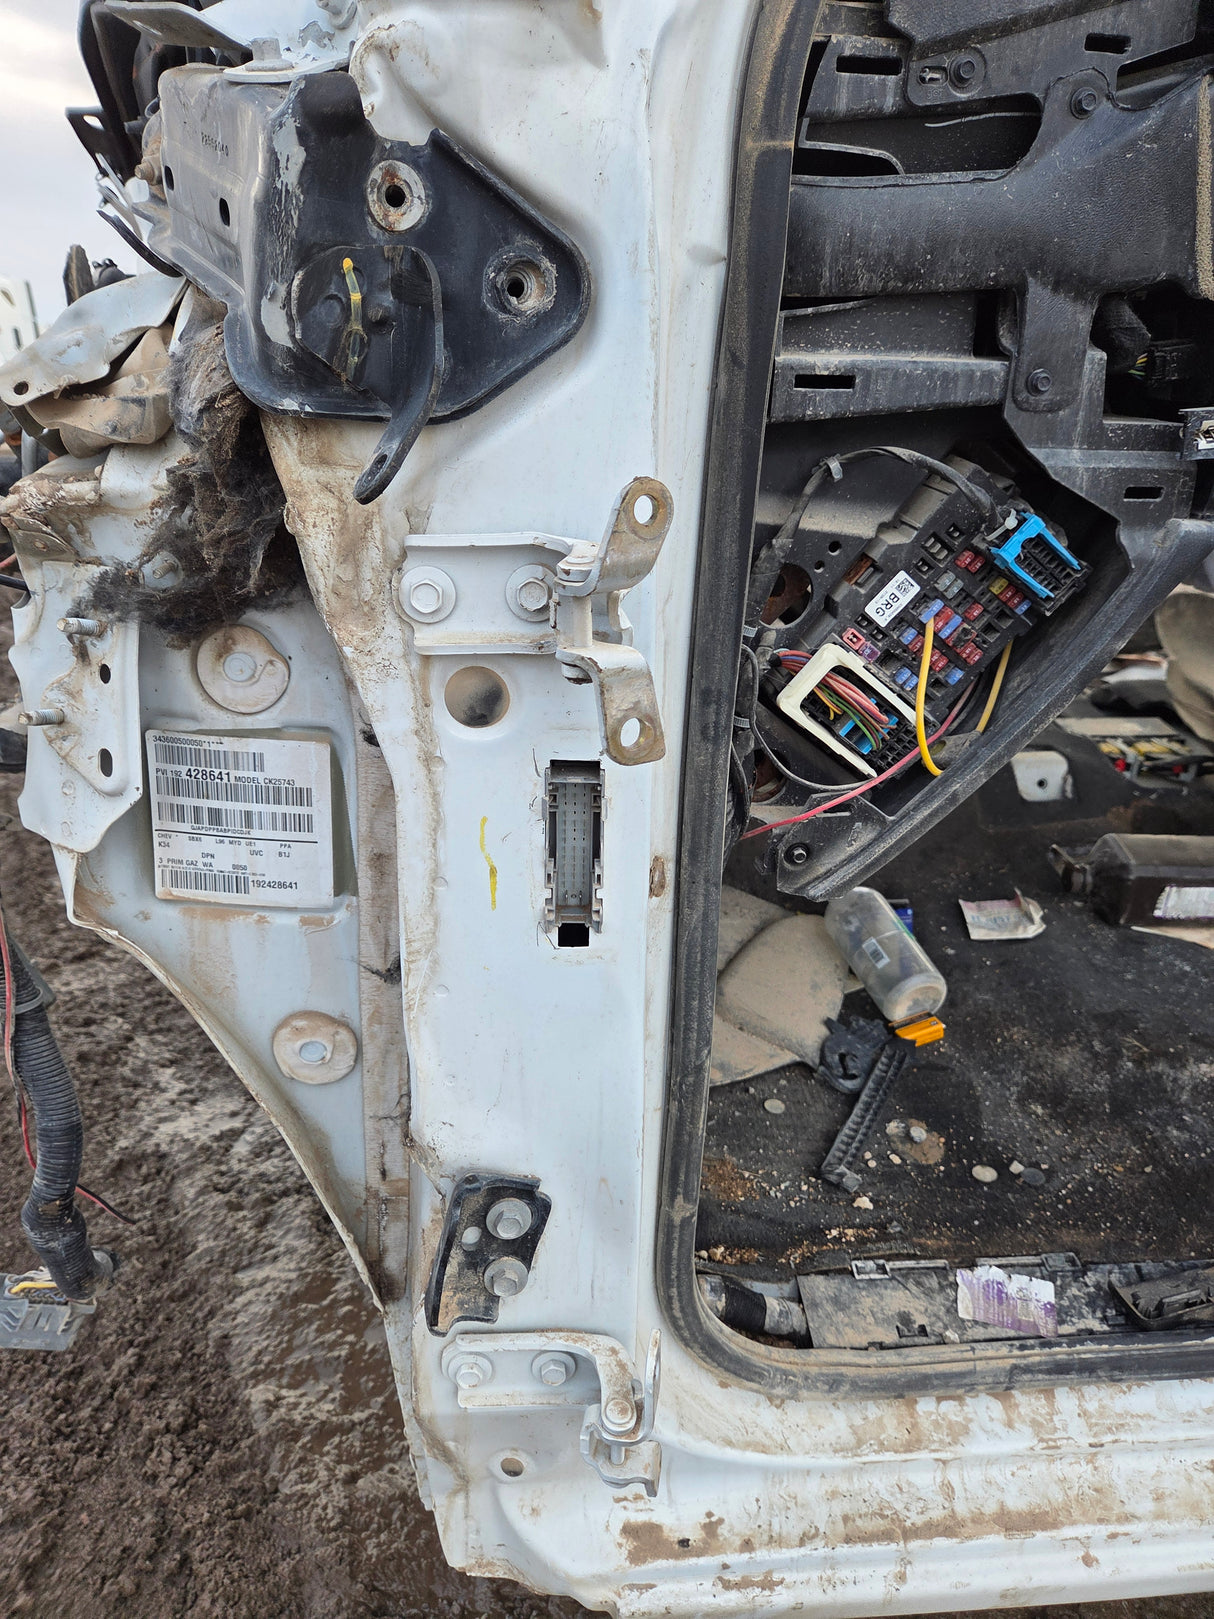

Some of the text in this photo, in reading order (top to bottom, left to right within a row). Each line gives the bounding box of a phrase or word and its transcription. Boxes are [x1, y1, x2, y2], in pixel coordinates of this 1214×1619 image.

[875, 592, 900, 617] BRG
[156, 767, 296, 787] PVI 192 428641 MODEL CK25743
[157, 832, 173, 840] CHEV
[249, 849, 264, 857] UVC
[166, 857, 184, 866] PRIM
[201, 860, 214, 868] WA
[250, 879, 298, 890] 192428641
